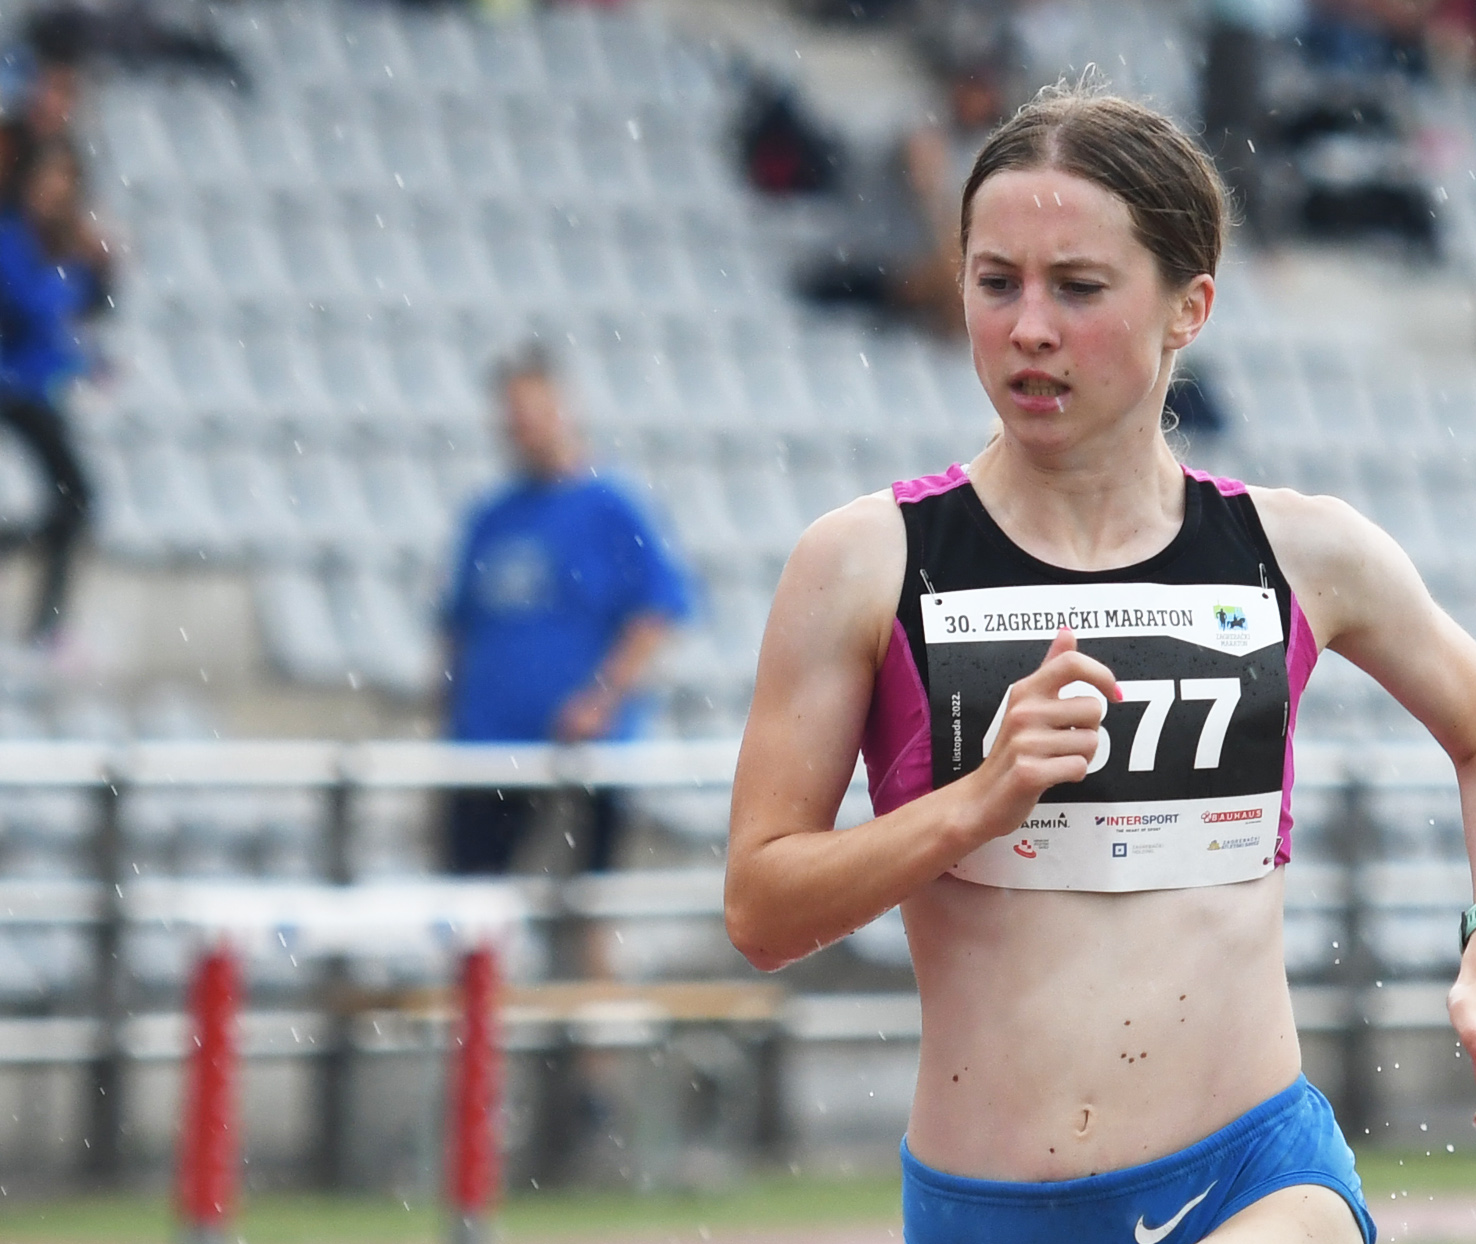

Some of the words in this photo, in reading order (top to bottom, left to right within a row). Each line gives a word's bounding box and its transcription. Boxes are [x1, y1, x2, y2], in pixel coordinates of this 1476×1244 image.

[944, 614, 977, 634] 30.
[983, 606, 1100, 632] ZAGREBAČKI
[1104, 609, 1194, 628] MARATON
[951, 691, 961, 718] 2022.
[951, 718, 963, 762] listopada
[1020, 818, 1069, 829] ARMIN
[1106, 813, 1180, 826] INTERSPORT
[1211, 810, 1262, 822] BAUHAUS
